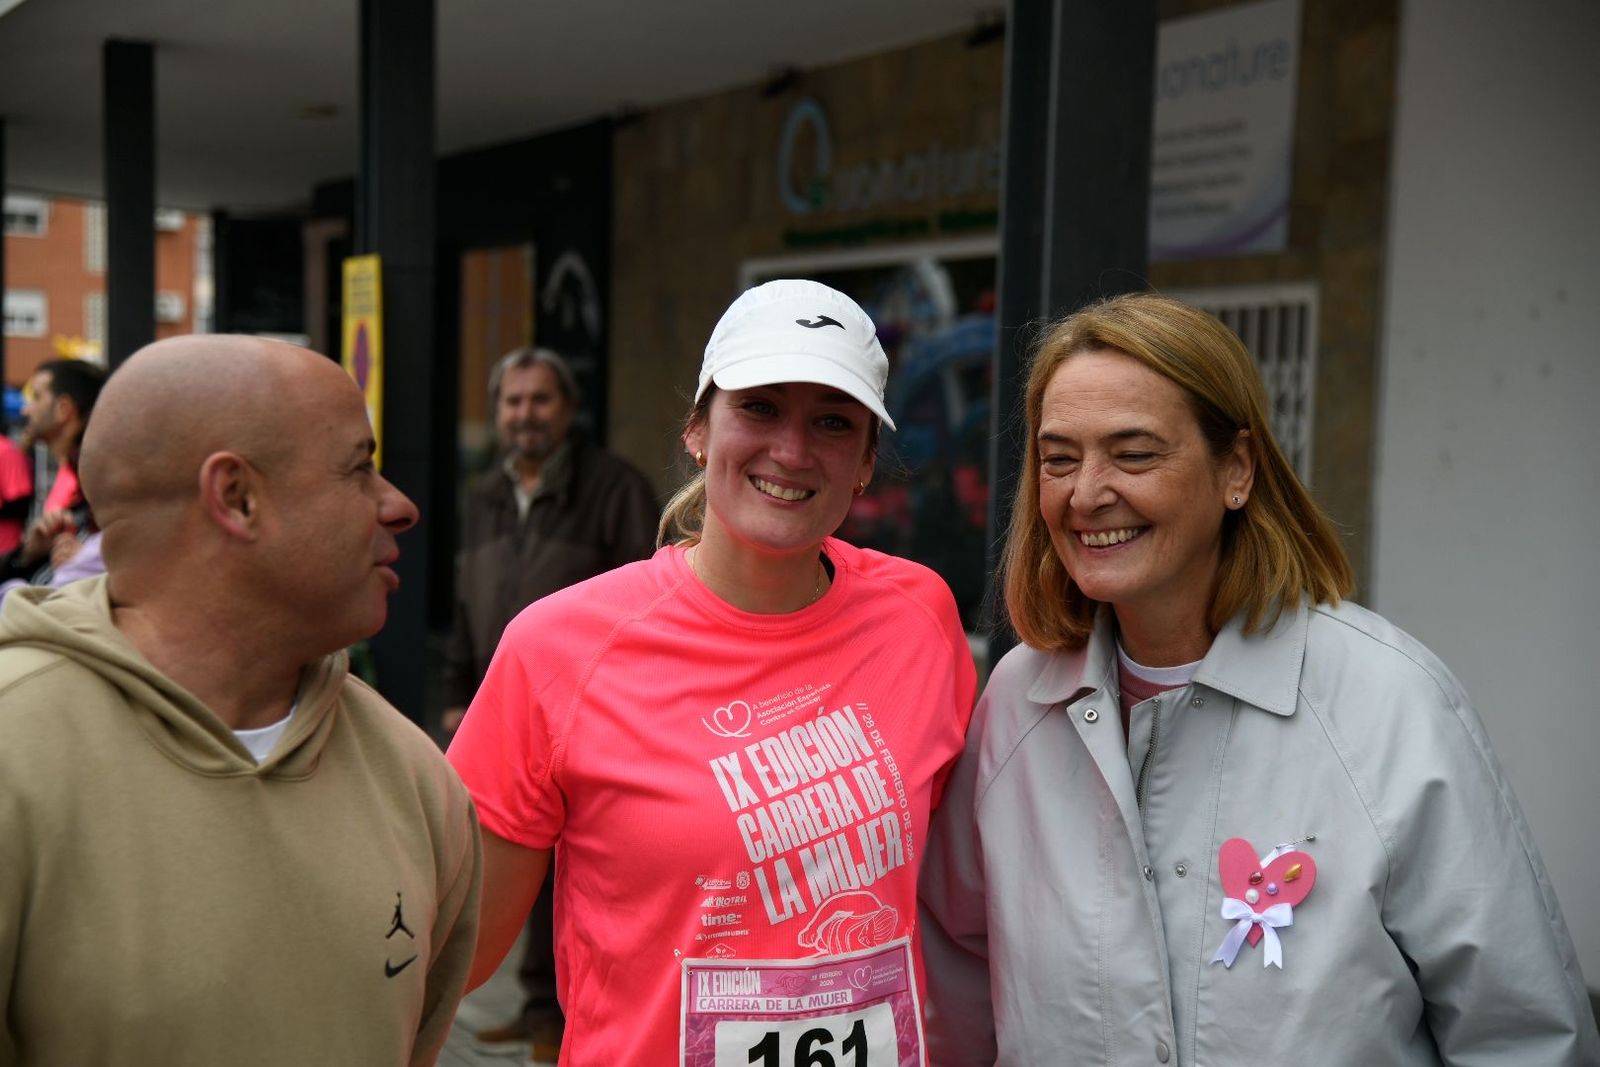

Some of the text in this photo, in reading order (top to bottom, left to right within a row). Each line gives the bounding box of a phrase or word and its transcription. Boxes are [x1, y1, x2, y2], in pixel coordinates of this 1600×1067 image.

[757, 699, 797, 719] Asociación
[759, 690, 793, 708] beneficio
[795, 686, 805, 695] de
[805, 684, 813, 692] la
[760, 713, 786, 726] Contra
[709, 705, 874, 813] IX EDICIÓN
[862, 713, 875, 728] 28
[870, 729, 885, 748] DE
[880, 748, 909, 808] FEBRERO
[902, 811, 913, 829] DE
[736, 759, 895, 864] CARRERA DE
[753, 812, 906, 925] LA MUJER
[697, 967, 761, 997] IX EDICIÓN
[699, 991, 848, 1011] CARRERA DE LA MUJER
[748, 1019, 868, 1067] 161
